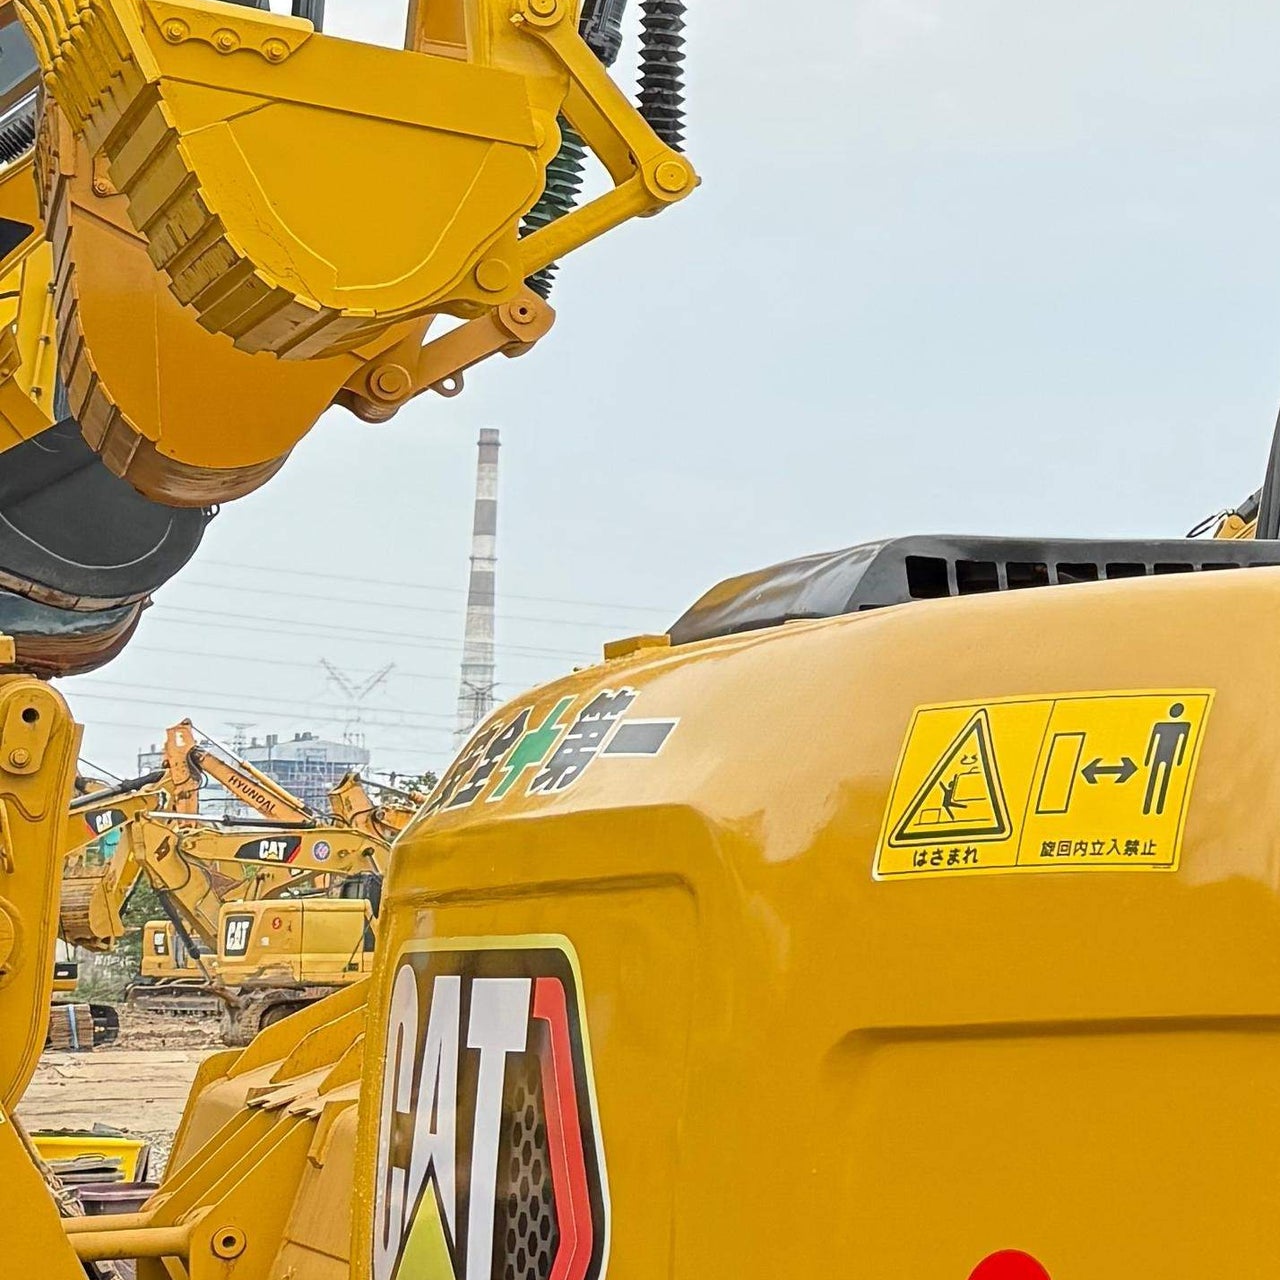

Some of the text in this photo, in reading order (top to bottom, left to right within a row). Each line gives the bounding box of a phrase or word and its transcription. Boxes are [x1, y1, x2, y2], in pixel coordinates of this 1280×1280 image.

[259, 840, 287, 860] CAT
[912, 845, 979, 867] はさまれ
[1040, 839, 1157, 858] 旋回内立入禁止
[226, 921, 250, 951] CAT
